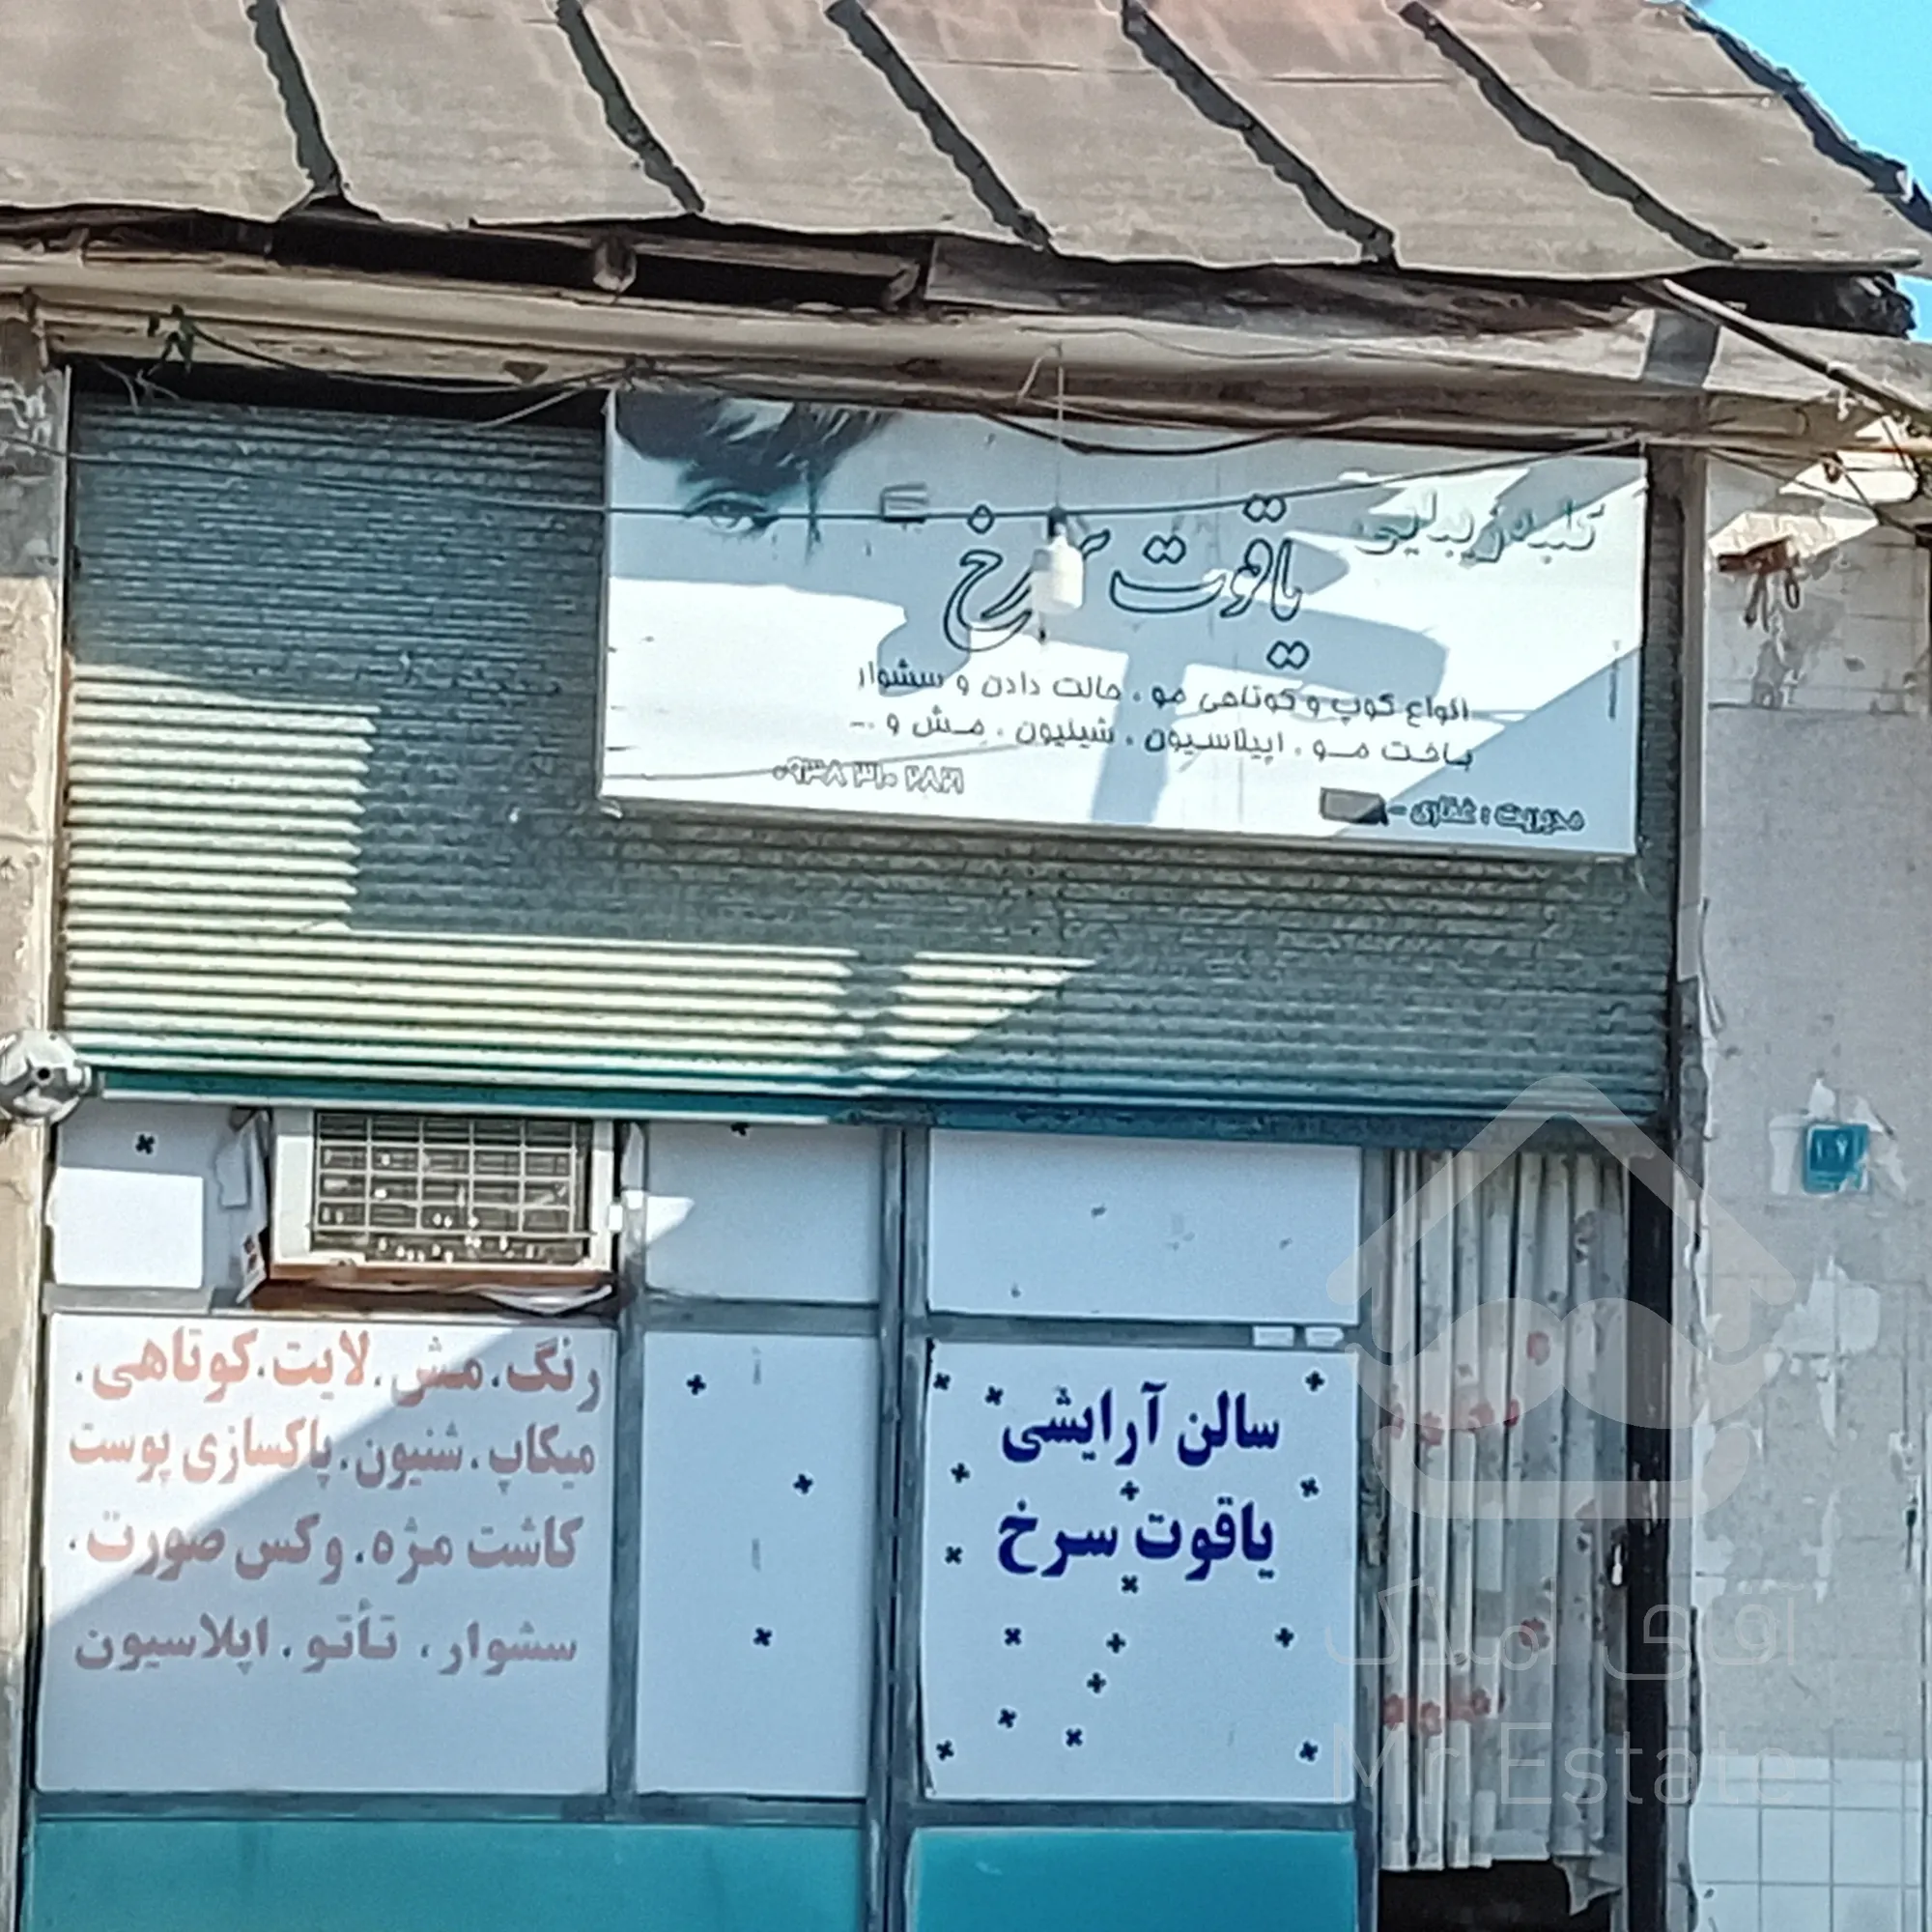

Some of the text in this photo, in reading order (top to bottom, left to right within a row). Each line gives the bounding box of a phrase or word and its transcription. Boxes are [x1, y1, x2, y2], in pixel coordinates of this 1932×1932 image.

[1109, 493, 1311, 670] یاقوت
[859, 659, 945, 691] سشوار
[956, 674, 970, 696] و
[981, 670, 1041, 697] دادن
[1198, 684, 1296, 714] کوتاهی
[1306, 693, 1321, 718] و
[1330, 692, 1395, 726] کوپ
[1406, 694, 1470, 728] انواع
[913, 704, 985, 737] مش
[1001, 1380, 1280, 1466] سالن آرایشی
[69, 1422, 172, 1489] پوست
[182, 1413, 333, 1490] پاکسازی
[467, 1515, 584, 1570] کاشت
[998, 1495, 1276, 1581] یاقوت سرخ
[74, 1611, 269, 1677] اپلاسیون
